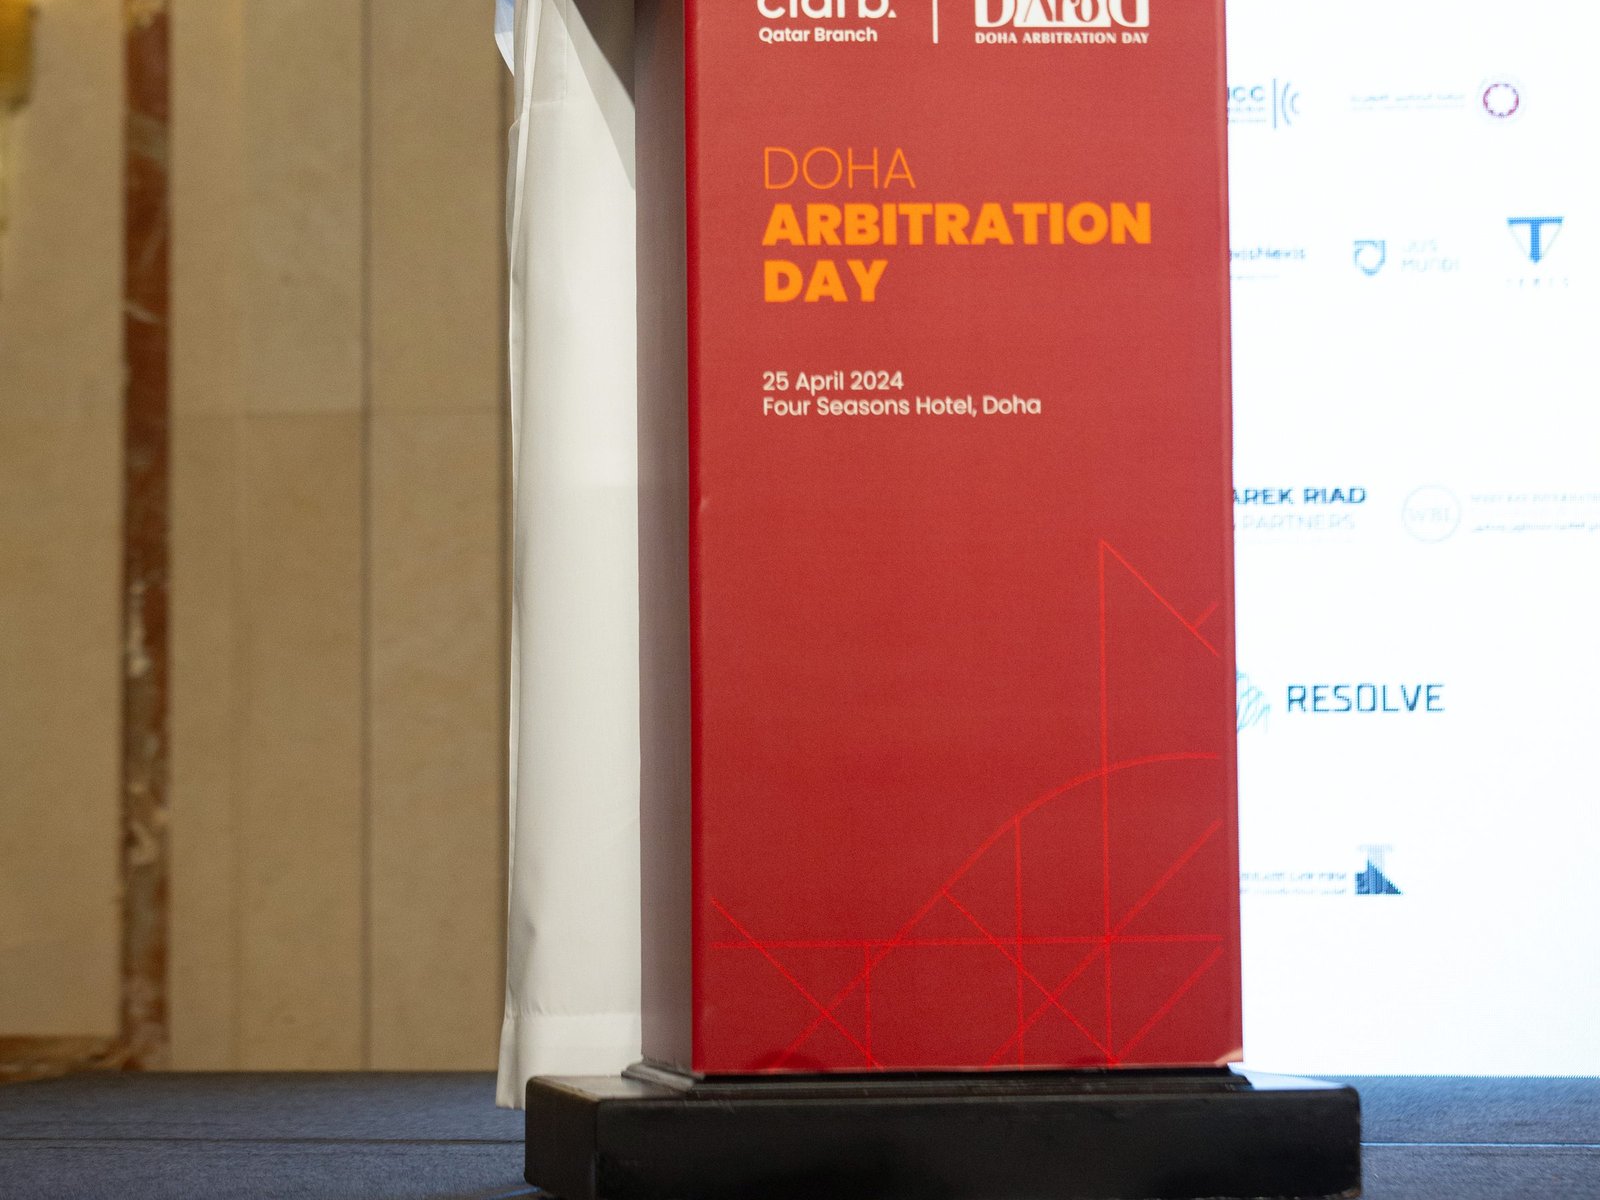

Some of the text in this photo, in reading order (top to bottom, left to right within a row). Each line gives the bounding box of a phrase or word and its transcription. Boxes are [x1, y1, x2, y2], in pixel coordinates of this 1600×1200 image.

[759, 27, 877, 43] Qatar Branch
[975, 32, 1148, 43] DOHA ARBITRATION DAY
[764, 147, 915, 189] DOHA
[762, 202, 1151, 246] ARBITRATION
[764, 259, 888, 302] DAY
[763, 371, 903, 396] 25 April 2024
[764, 395, 1041, 417] Four Seasons Hotel, Doha
[1302, 487, 1367, 504] RIAD
[1286, 683, 1445, 713] RESOLVE
